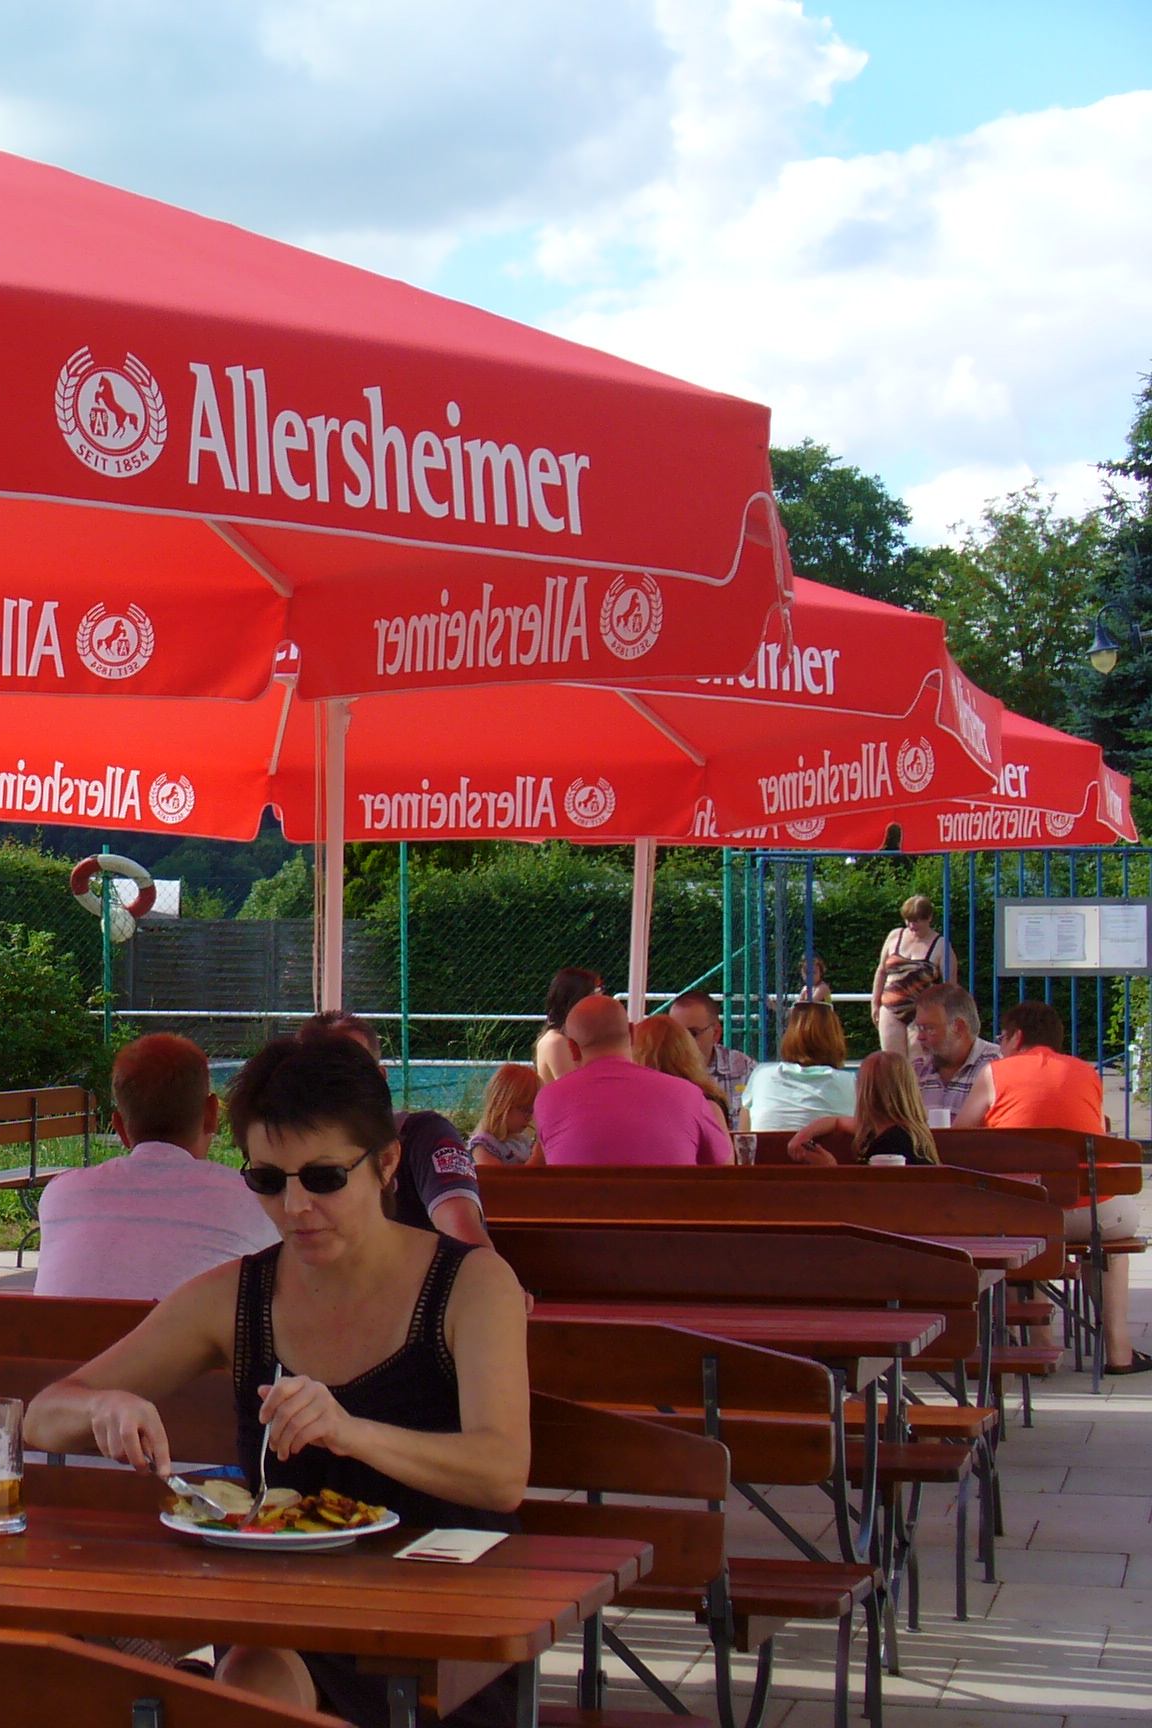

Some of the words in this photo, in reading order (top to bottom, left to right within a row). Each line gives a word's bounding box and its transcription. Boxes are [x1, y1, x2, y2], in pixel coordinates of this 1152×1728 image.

[75, 443, 109, 472] SEIT
[114, 449, 150, 474] 1854
[188, 361, 590, 536] Allersheimer
